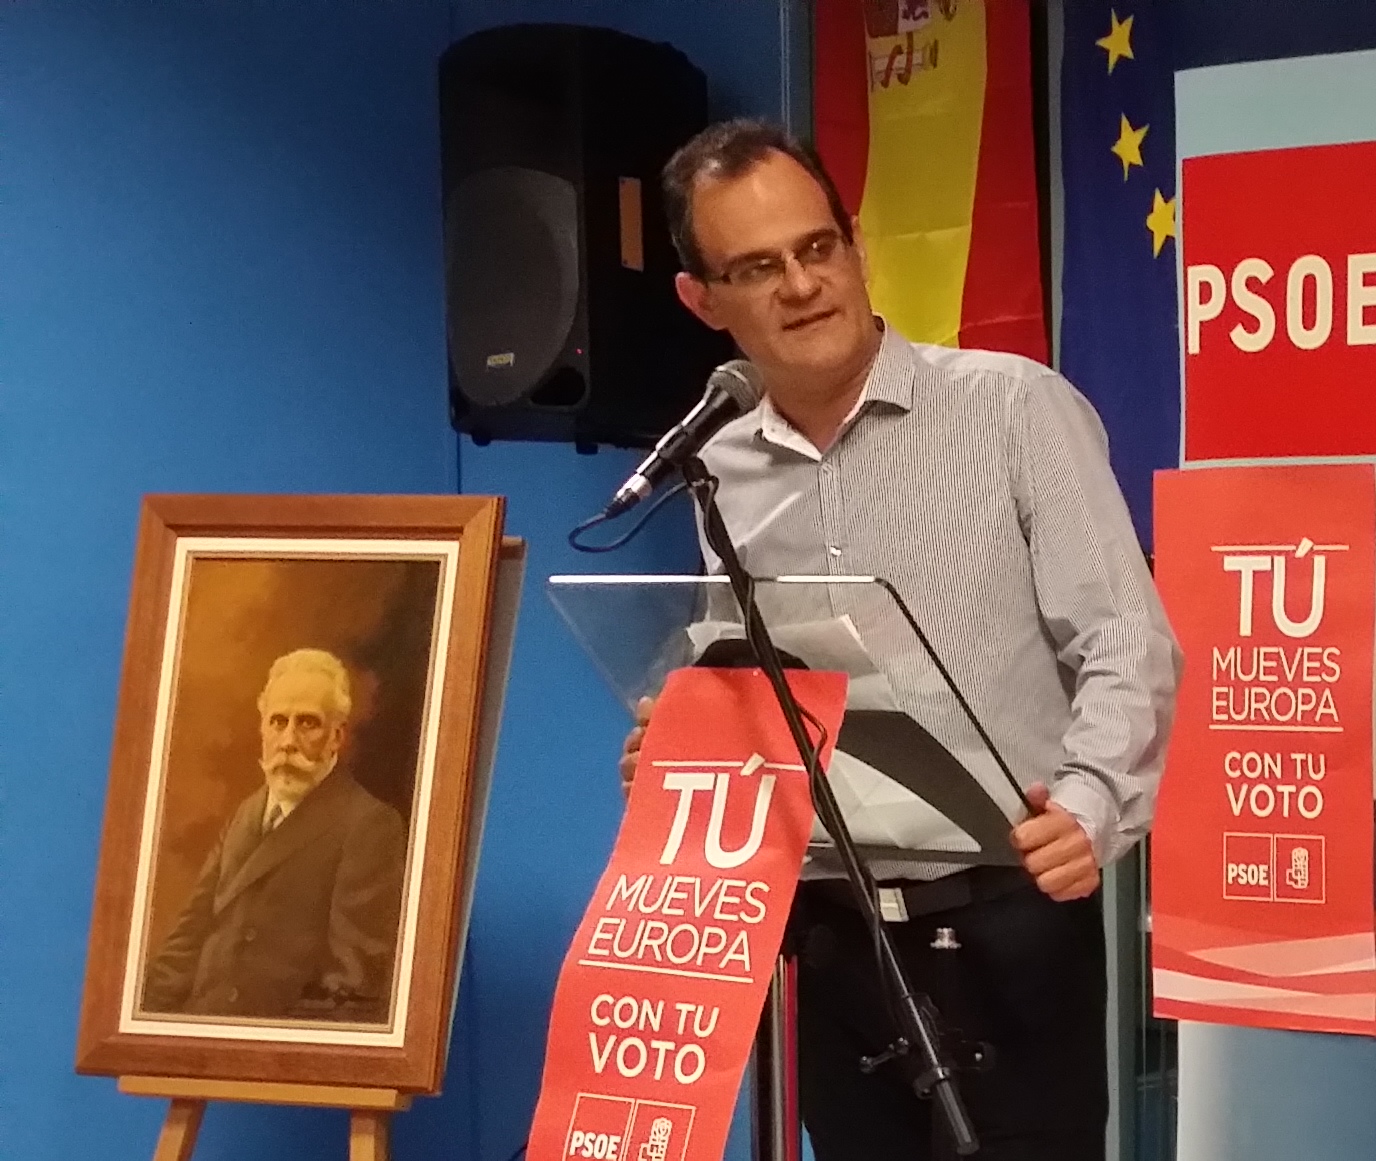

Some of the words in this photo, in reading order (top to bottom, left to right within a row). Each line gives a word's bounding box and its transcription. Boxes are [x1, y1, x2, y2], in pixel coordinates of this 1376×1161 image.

[1223, 537, 1327, 639] TÚ
[1212, 646, 1341, 683] MUEVES
[1212, 686, 1340, 722] EUROPA
[1224, 751, 1282, 779] CON
[1290, 753, 1326, 781] TU
[659, 752, 777, 869] TÚ
[1225, 783, 1323, 819] VOTO
[1227, 863, 1269, 886] PSOE
[605, 873, 770, 925] MUEVES
[588, 917, 752, 972] EUROPA
[590, 993, 663, 1033] CON
[674, 1001, 720, 1039] TU
[589, 1032, 707, 1085] VOTO
